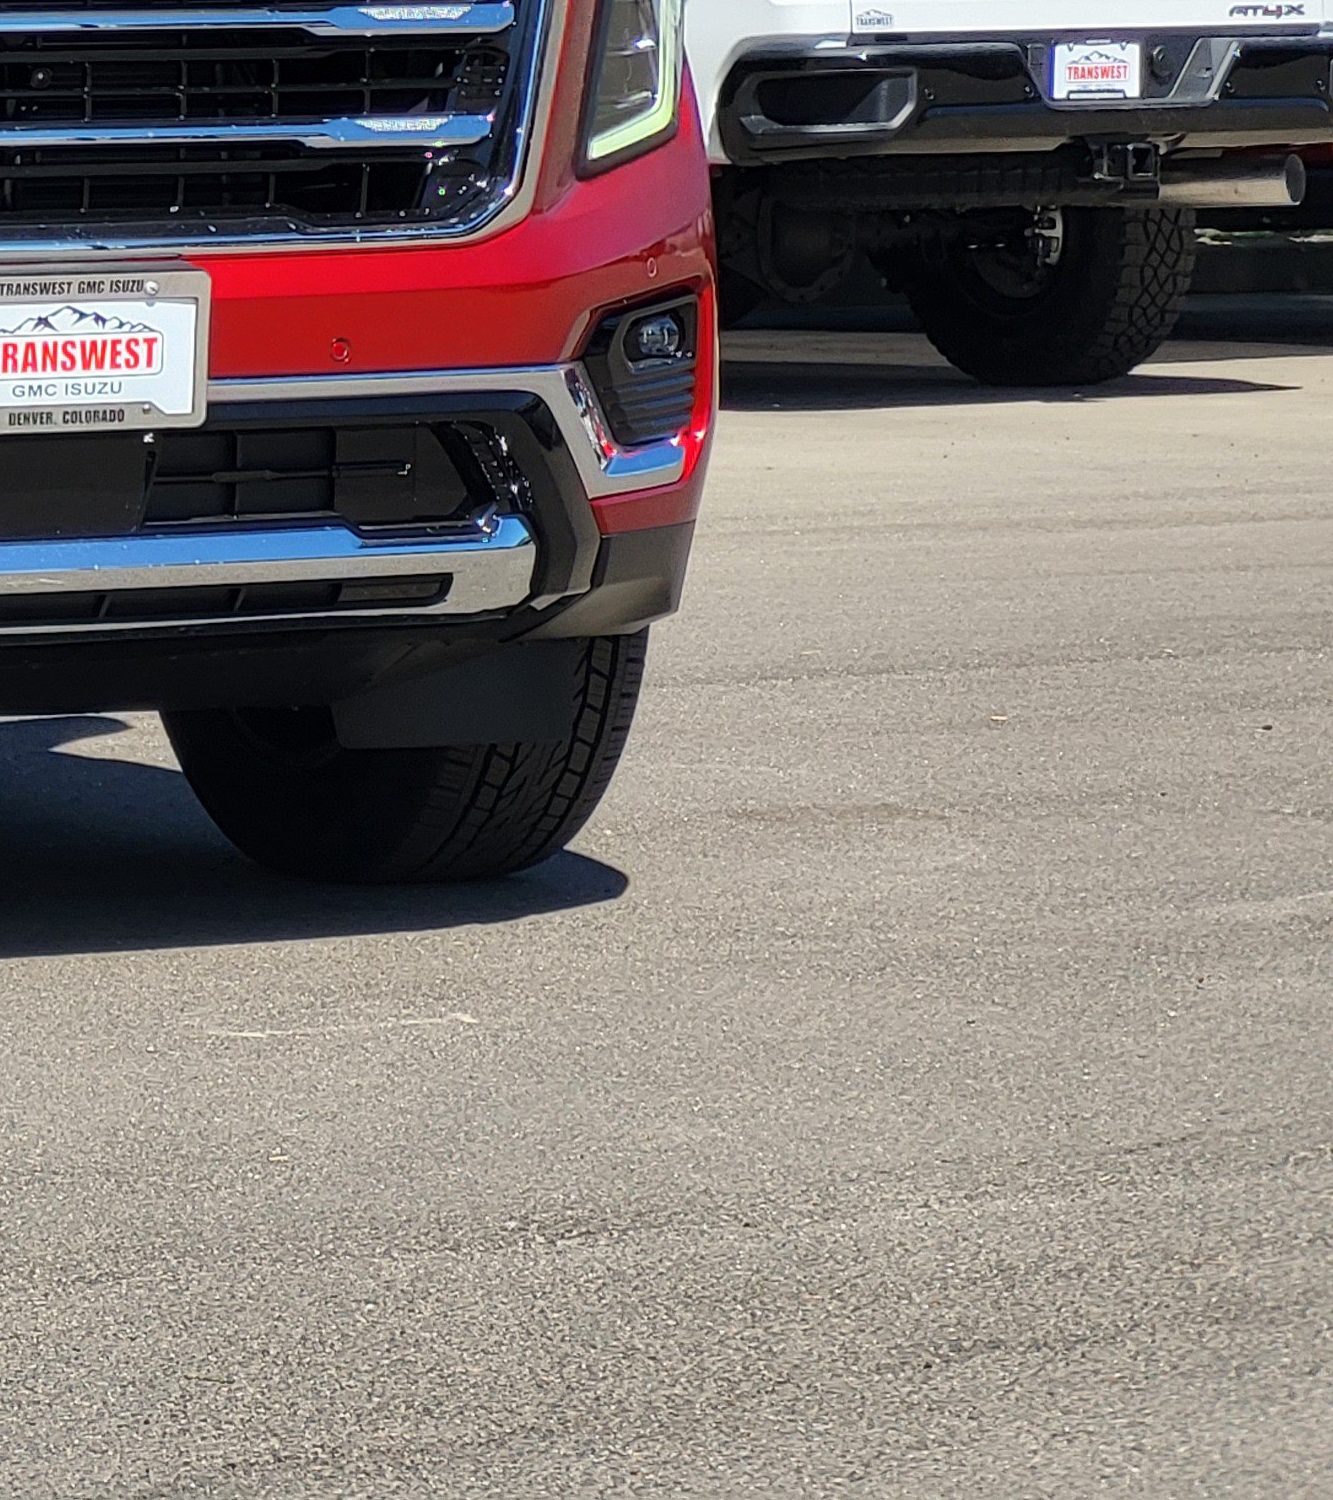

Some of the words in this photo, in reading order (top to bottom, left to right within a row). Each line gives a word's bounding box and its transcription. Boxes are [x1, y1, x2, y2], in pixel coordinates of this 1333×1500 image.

[1229, 4, 1305, 19] AT4X
[1067, 64, 1129, 82] TRANSWEST
[0, 281, 73, 297] TRANSWEST
[77, 281, 106, 295] GMC
[109, 280, 145, 293] ISUZU
[11, 383, 59, 398] GMC
[64, 381, 123, 396] ISUZU
[62, 409, 126, 424] COLORADO
